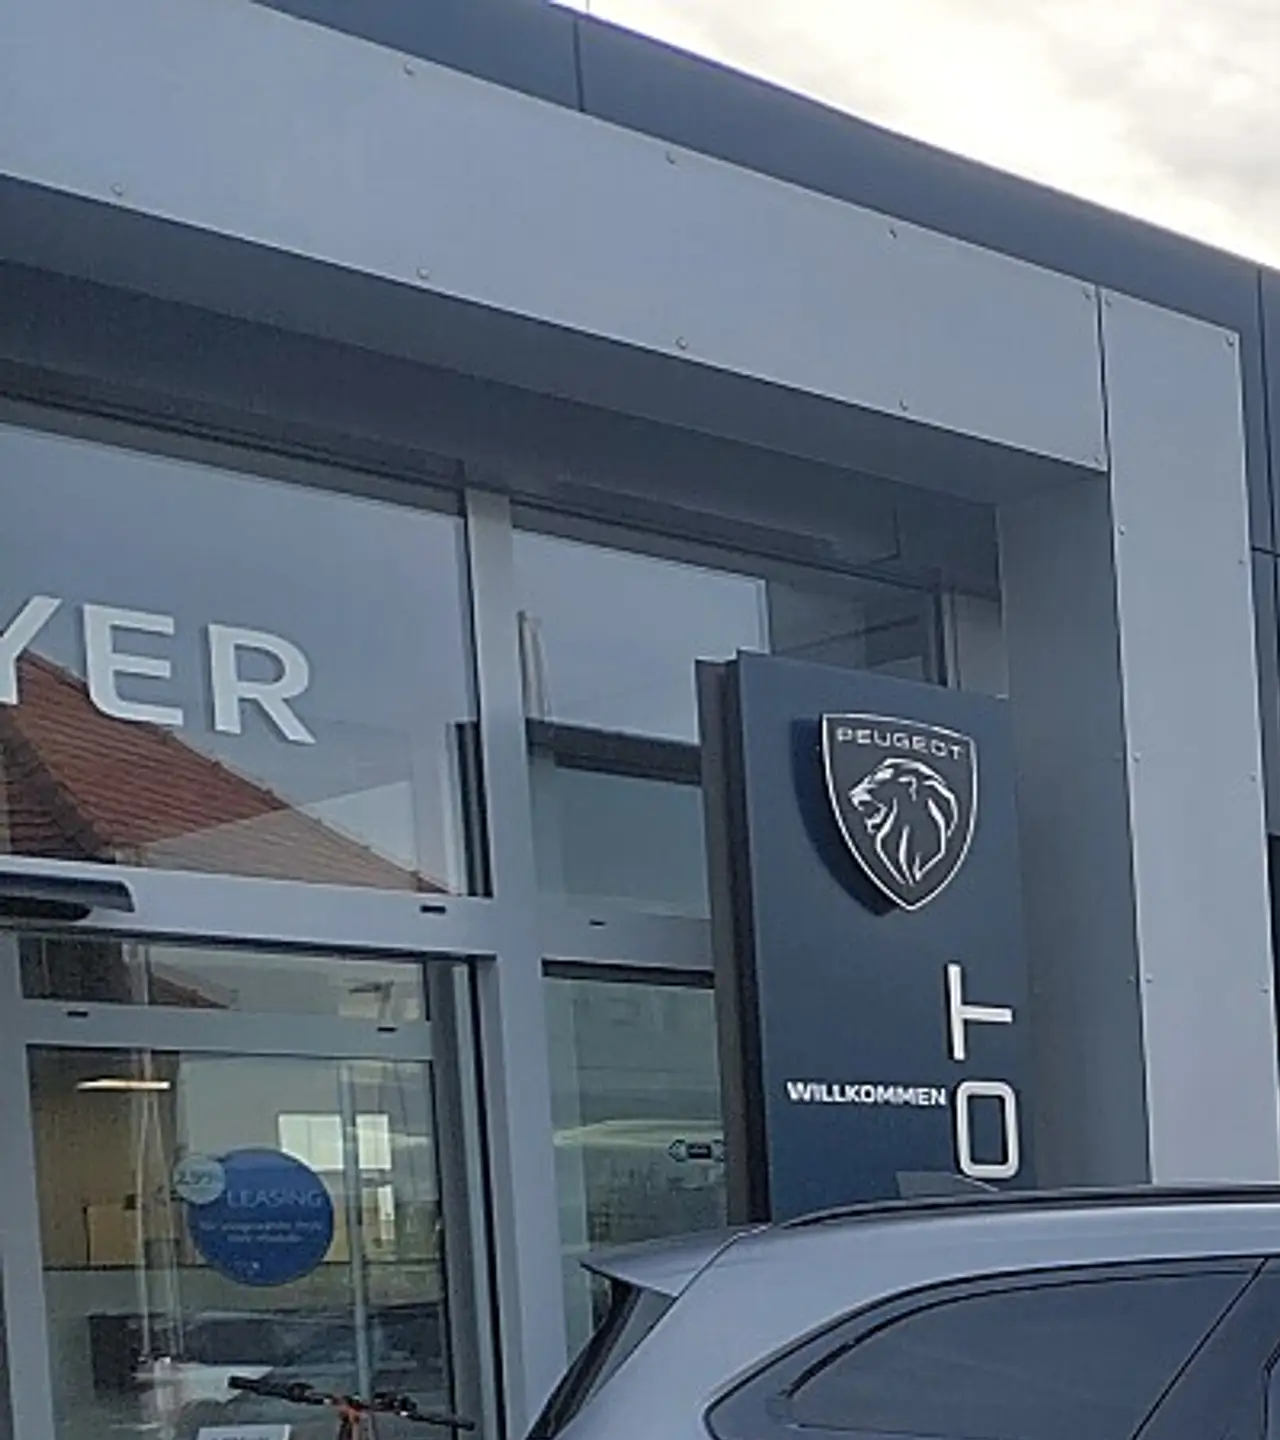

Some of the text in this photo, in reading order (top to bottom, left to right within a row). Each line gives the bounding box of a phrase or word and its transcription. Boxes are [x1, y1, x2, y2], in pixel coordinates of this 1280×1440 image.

[836, 726, 964, 760] PEUGEOT
[786, 1080, 948, 1107] WILLKOMMEN
[226, 1188, 323, 1208] LEASING
